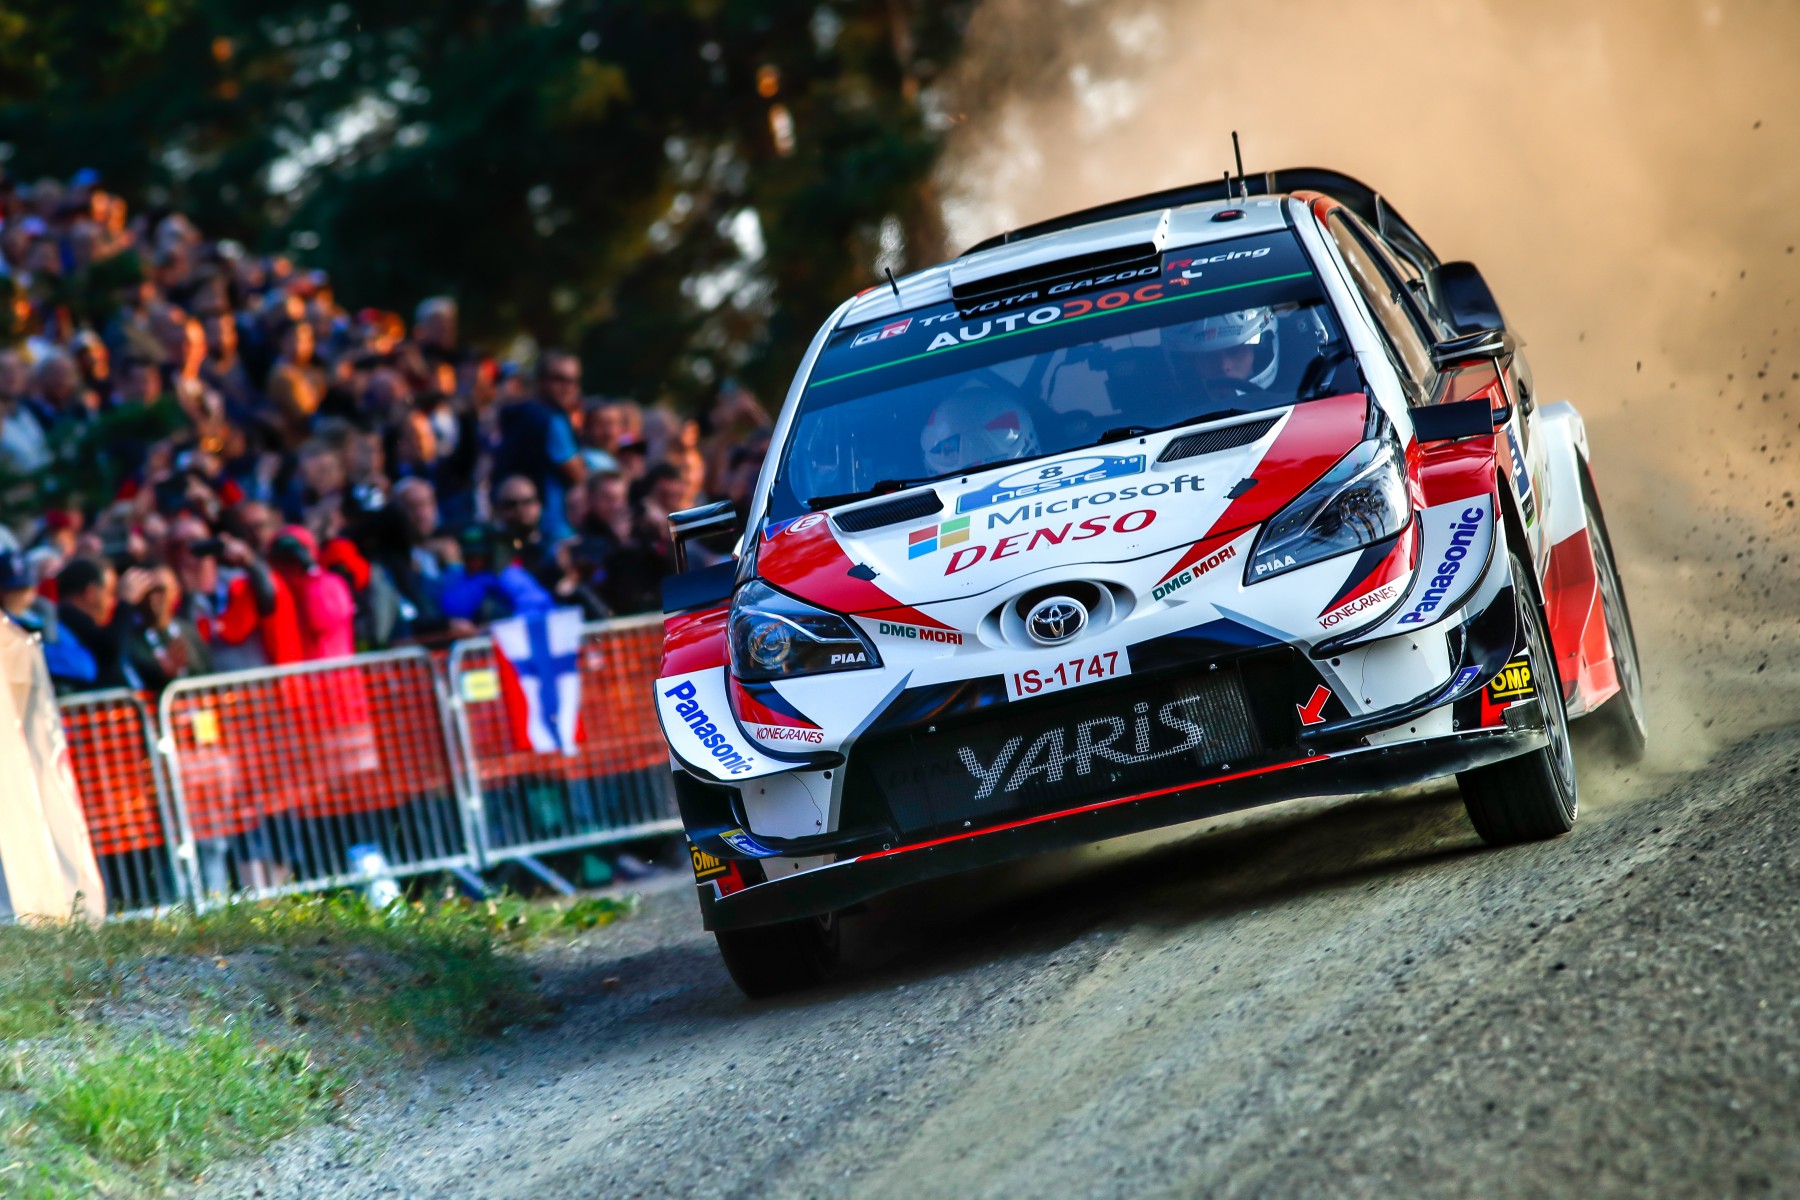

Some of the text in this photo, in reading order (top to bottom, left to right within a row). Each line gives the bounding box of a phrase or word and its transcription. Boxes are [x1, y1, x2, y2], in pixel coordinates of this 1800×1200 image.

[854, 247, 1271, 346] GR TOYOTA GAZOO Racing
[926, 284, 1164, 352] AUTODOC
[1038, 466, 1063, 480] 8
[988, 474, 1205, 529] Microsoft
[944, 509, 1157, 577] DENSO
[1255, 555, 1296, 575] PIAA
[1152, 545, 1237, 601] DMG MORI
[1397, 507, 1484, 625] Panasonic
[1319, 586, 1398, 630] KONECRANES
[880, 622, 963, 645] DMG MORI
[831, 652, 866, 664] PIAA
[1014, 651, 1118, 696] IS-1747
[1490, 667, 1531, 691] OMP
[664, 680, 753, 775] Panasonic
[756, 727, 824, 744] KONECRANES
